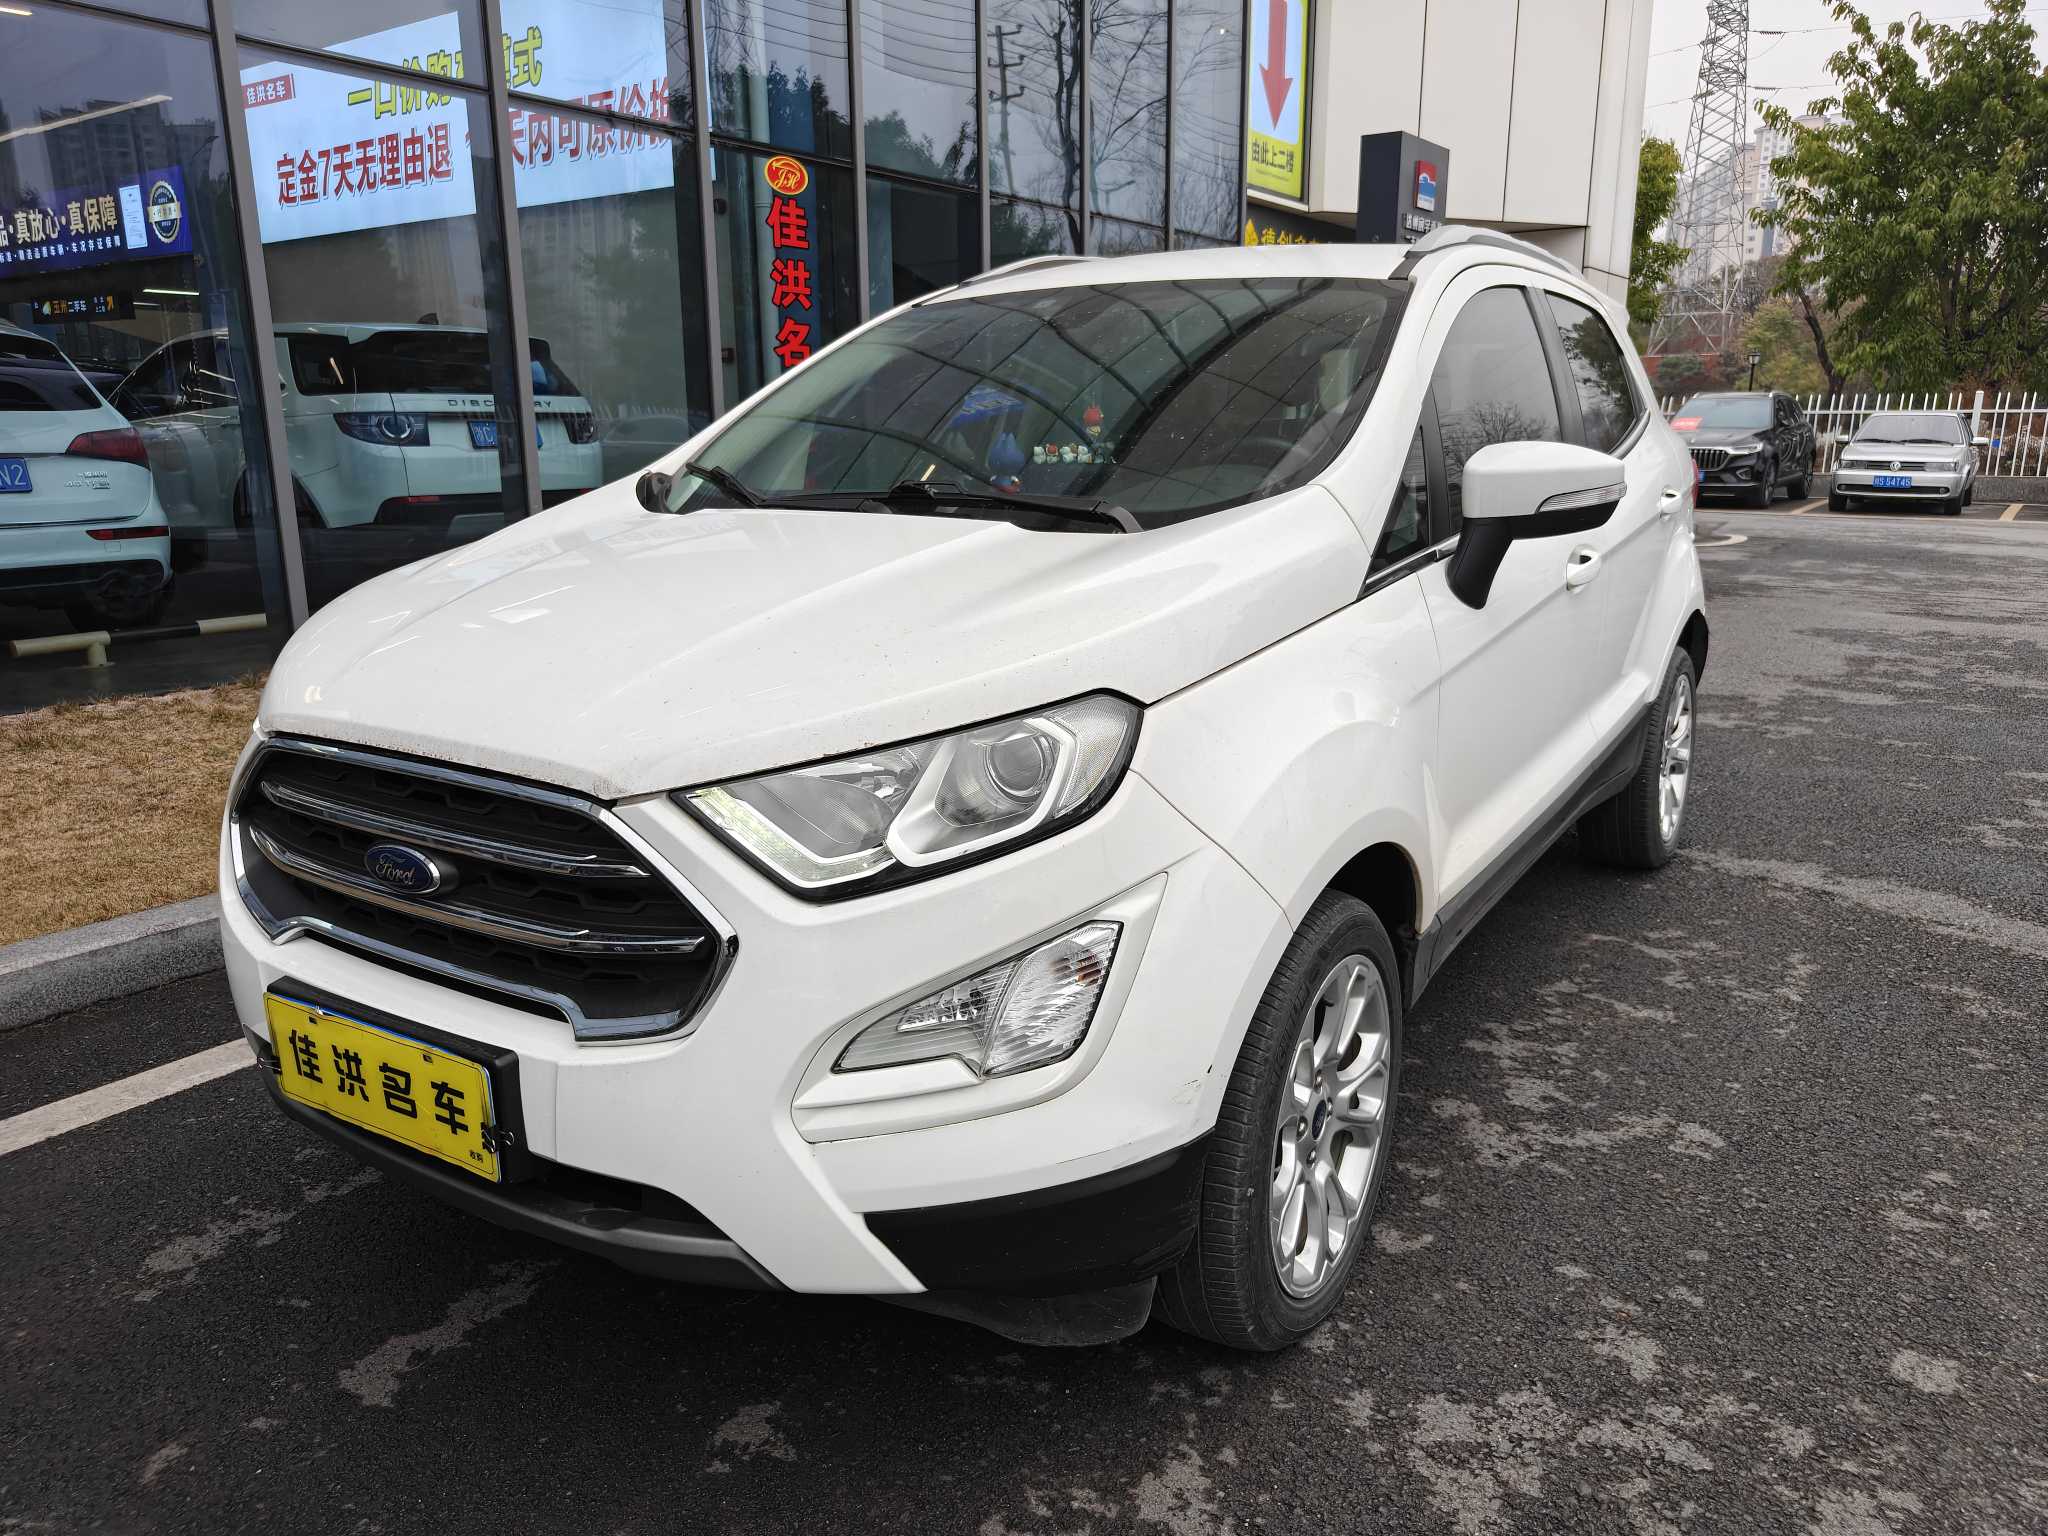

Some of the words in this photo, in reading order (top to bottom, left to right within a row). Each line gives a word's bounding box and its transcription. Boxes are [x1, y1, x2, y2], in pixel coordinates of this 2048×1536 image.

[277, 121, 453, 208] 定金7天无理由退
[375, 853, 416, 885] Ford
[288, 1029, 469, 1135] 佳洪名车
